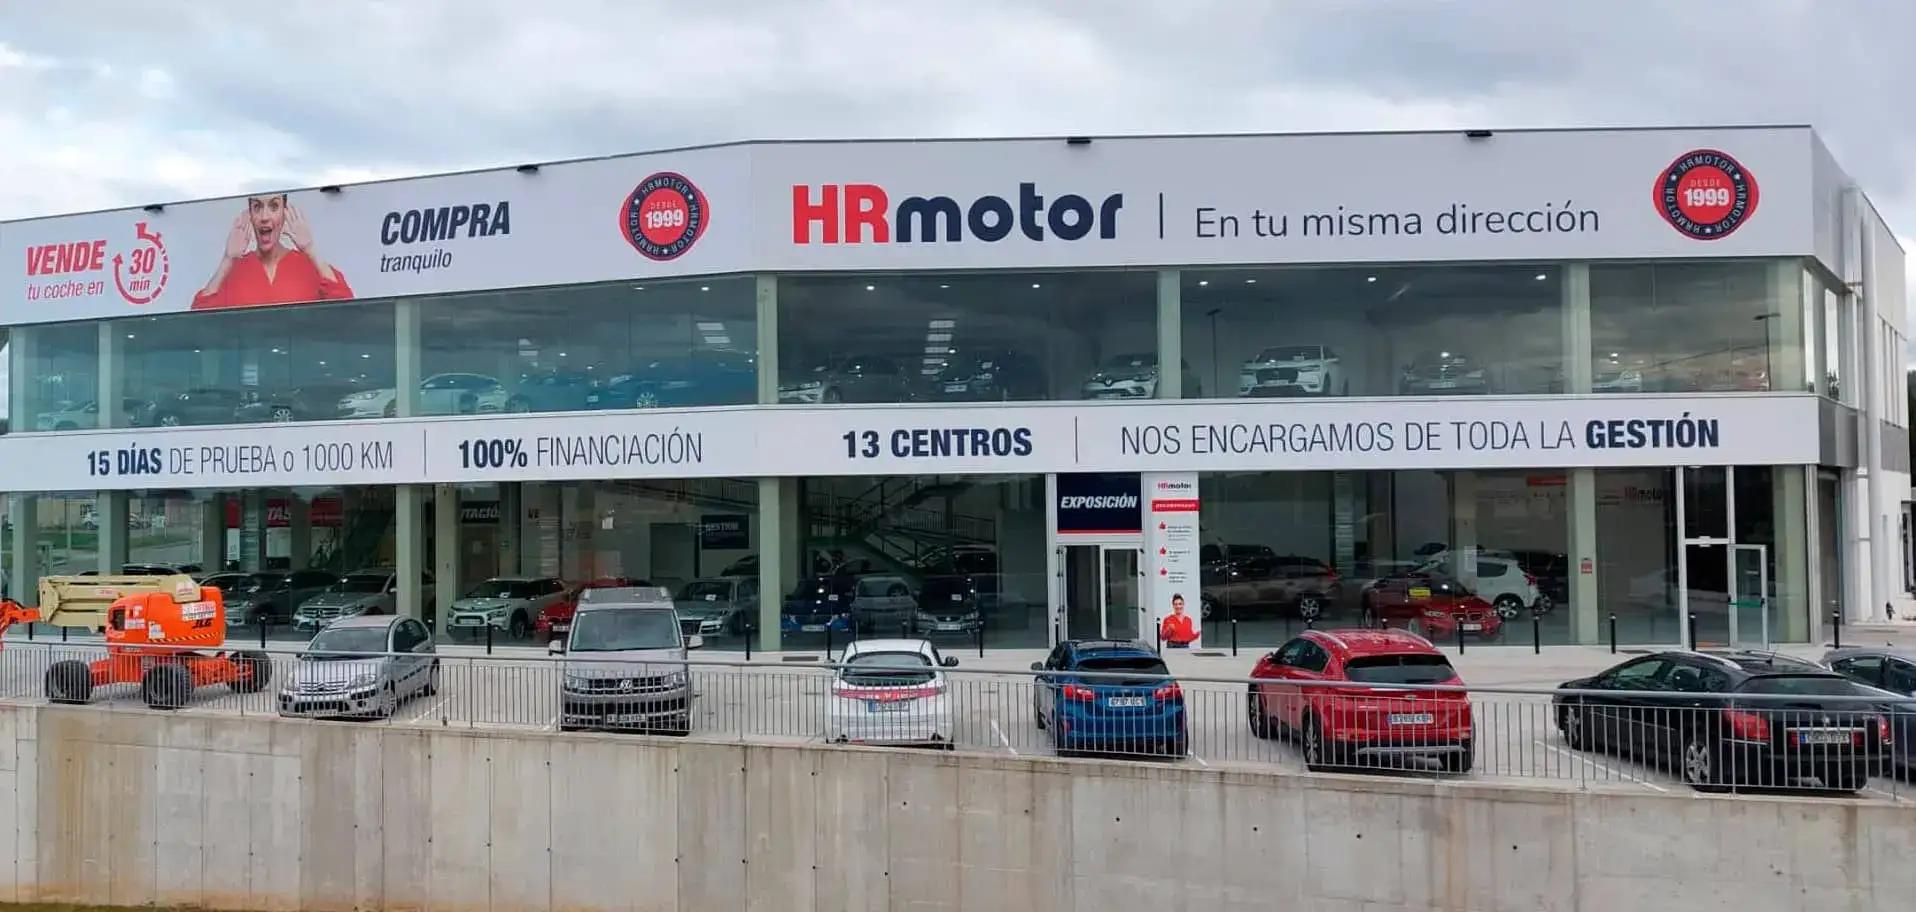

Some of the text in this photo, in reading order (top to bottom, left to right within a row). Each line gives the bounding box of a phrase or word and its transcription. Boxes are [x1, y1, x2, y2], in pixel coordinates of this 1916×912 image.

[1684, 187, 1729, 207] 1999
[380, 201, 510, 246] COMPRA
[645, 208, 684, 229] 1999
[1196, 199, 1599, 238] En tu misma dirección
[26, 240, 107, 276] VENDE
[129, 247, 156, 275] 30
[380, 248, 452, 274] tranquilo
[28, 281, 104, 300] tu coche en
[129, 279, 151, 292] min
[458, 427, 702, 469] 100% FINANCIACIÓN
[843, 427, 1033, 459] 13 CENTROS
[1121, 411, 1719, 455] NOS ENCARGAMOS DE TODA LA GESTIÓN
[87, 440, 393, 476] 15 DÍAS DE PRUEBA o 1000 KM
